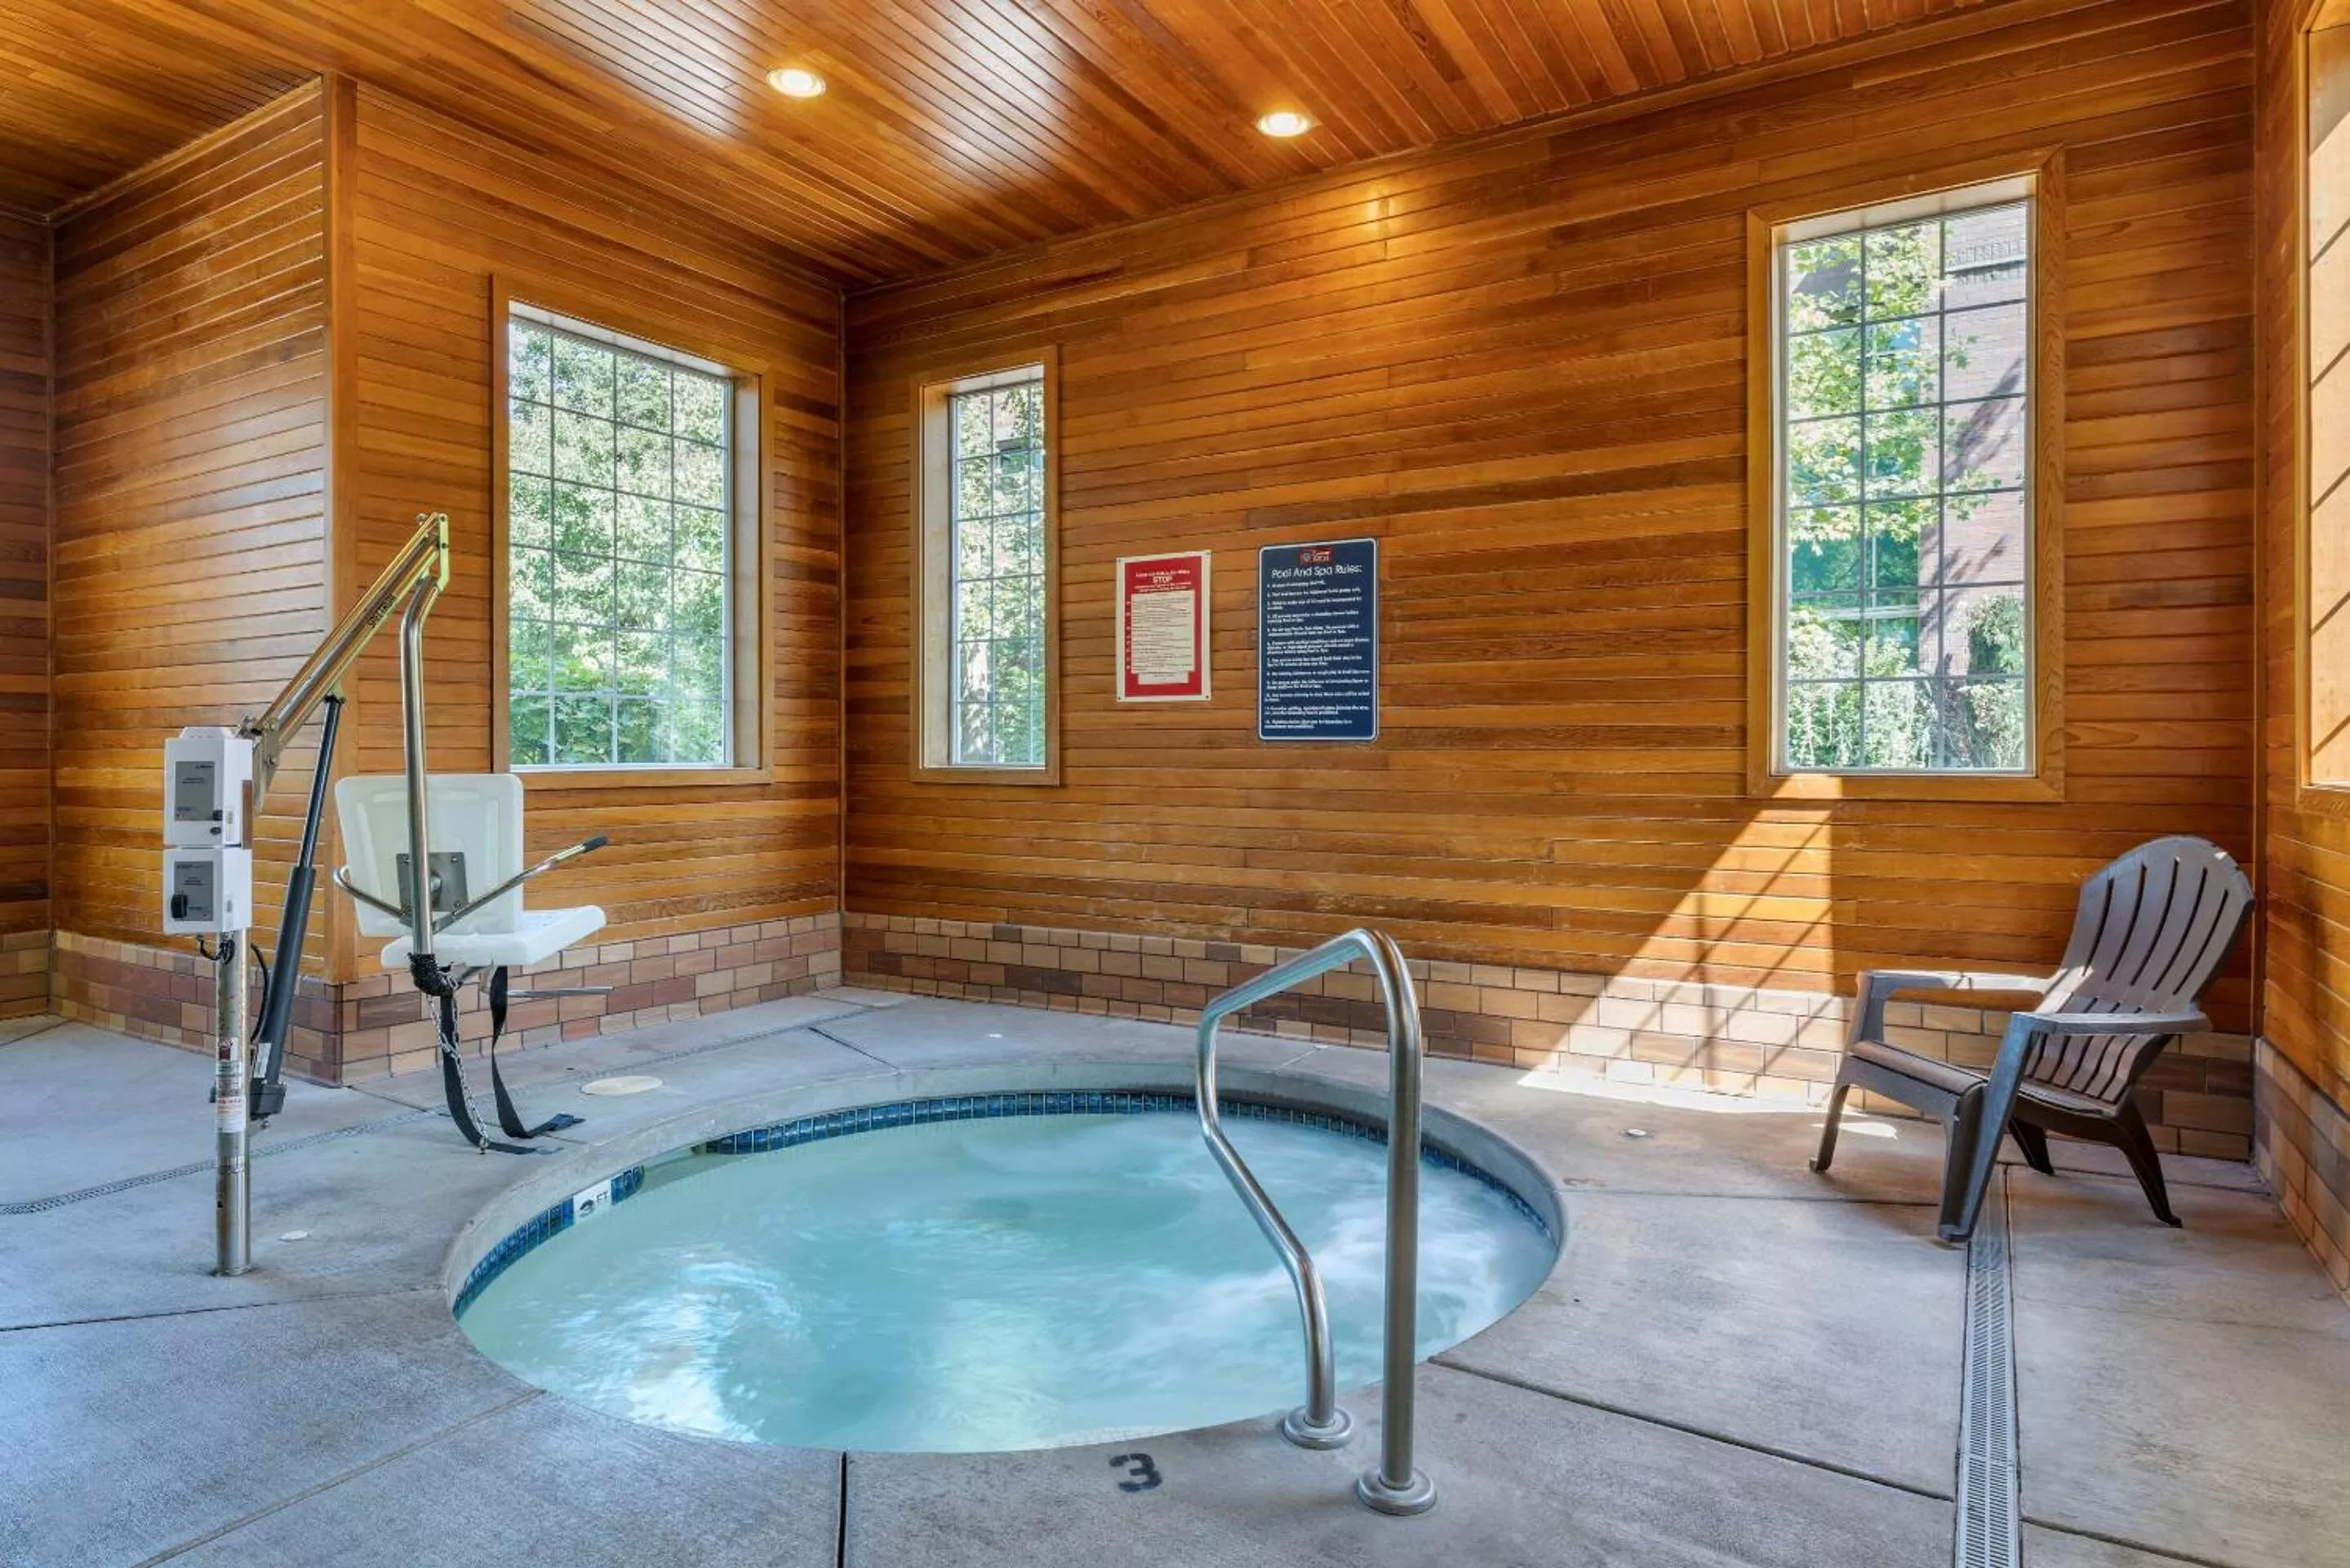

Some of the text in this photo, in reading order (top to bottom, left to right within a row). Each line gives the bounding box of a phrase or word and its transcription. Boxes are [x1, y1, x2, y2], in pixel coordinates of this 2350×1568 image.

[1272, 564, 1363, 579] Pool And Spa Rules:
[1153, 575, 1173, 584] STOP
[1108, 1452, 1162, 1493] 3
